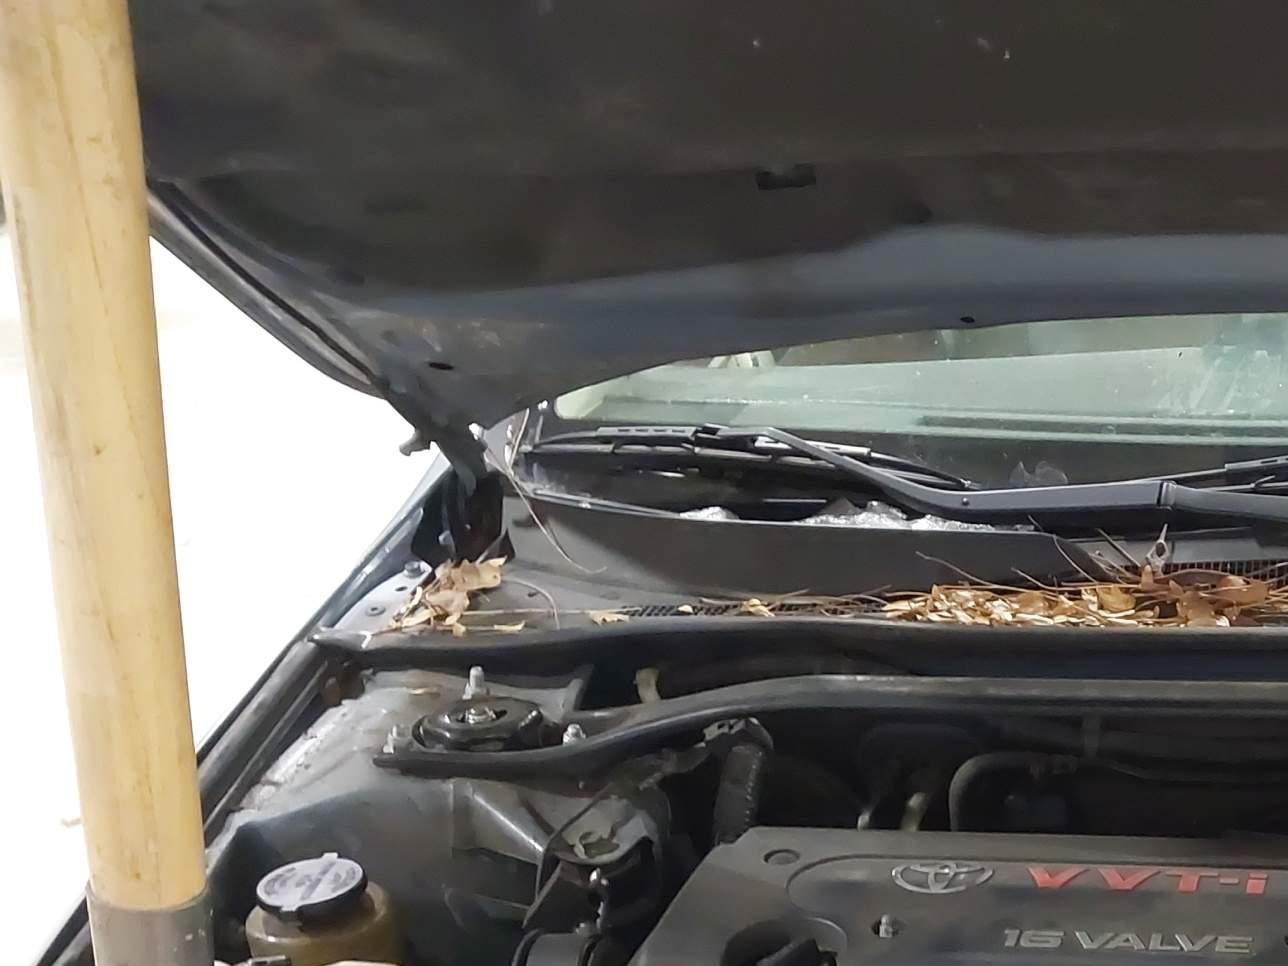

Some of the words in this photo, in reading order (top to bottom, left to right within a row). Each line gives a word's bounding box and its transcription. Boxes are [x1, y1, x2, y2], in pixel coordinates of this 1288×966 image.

[1027, 866, 1269, 895] VVT-i
[1004, 928, 1065, 949] 16
[1074, 930, 1255, 954] VALVE
